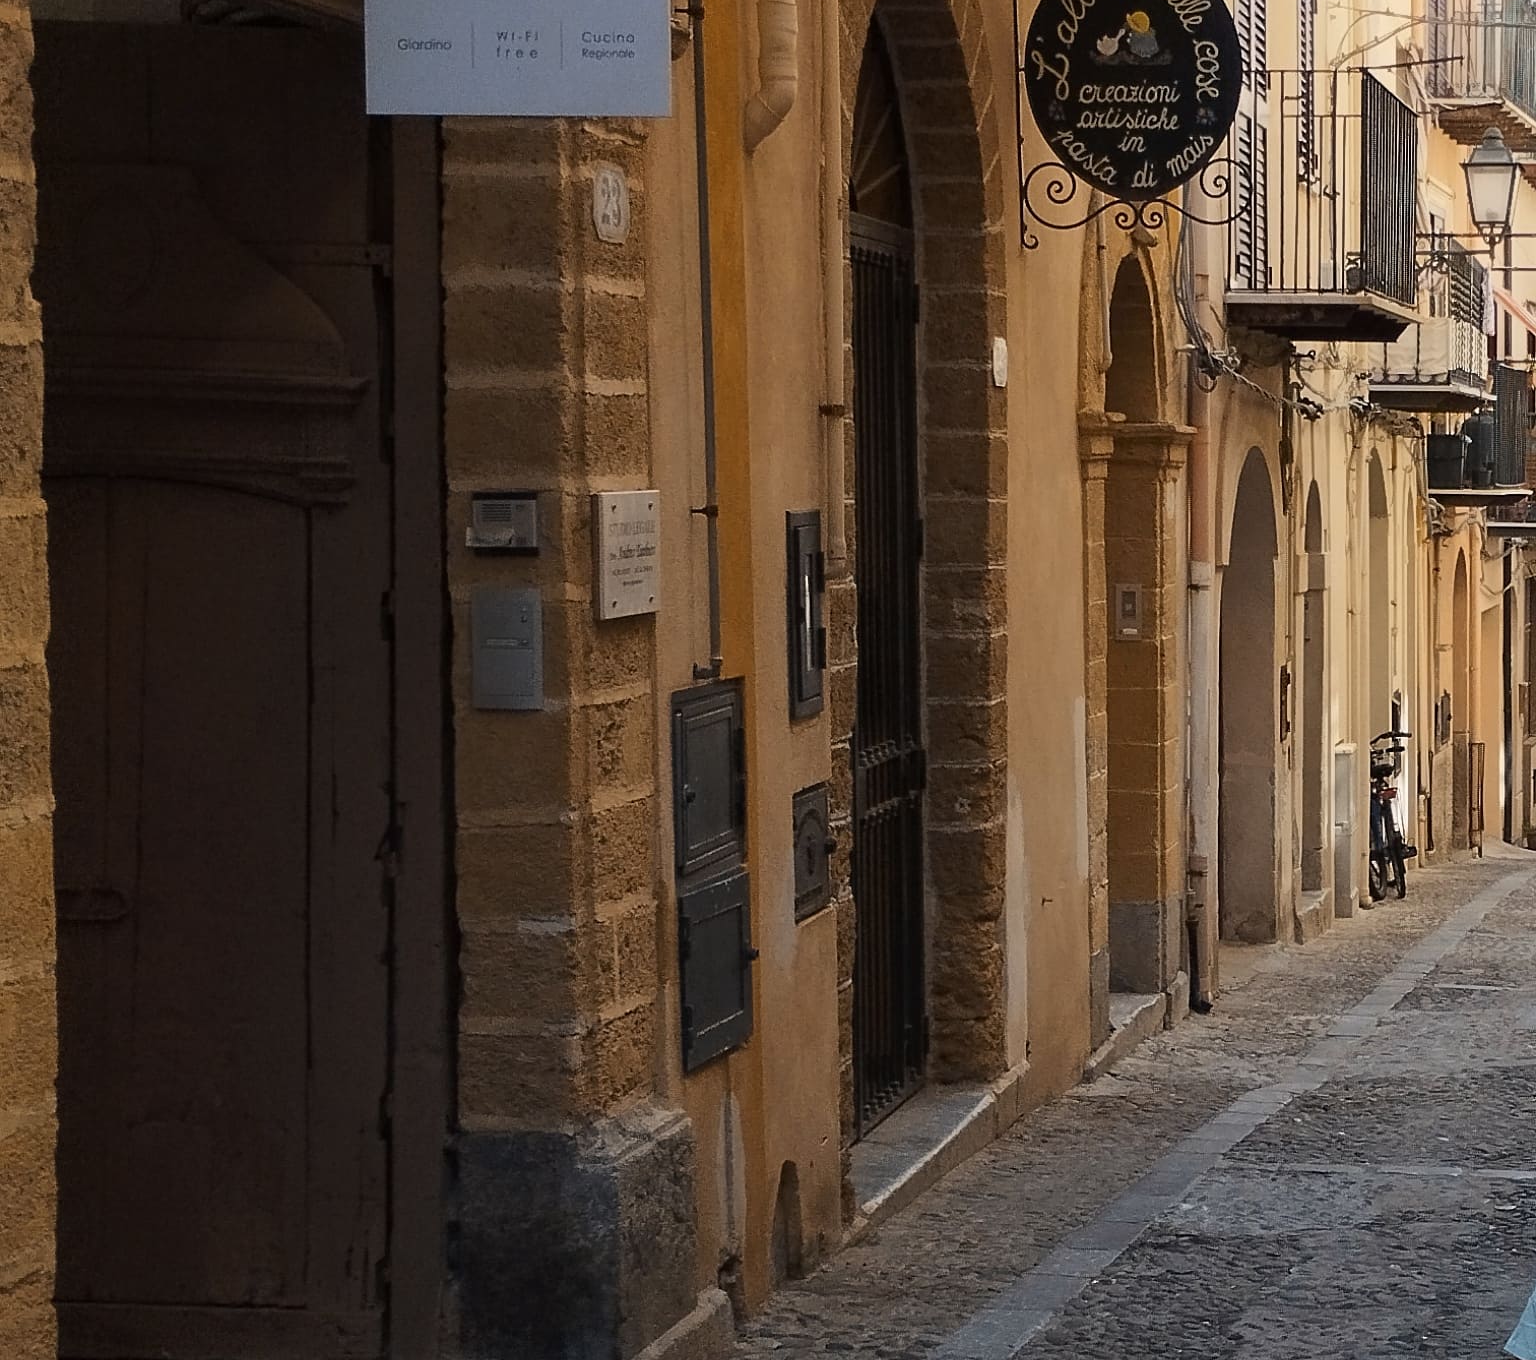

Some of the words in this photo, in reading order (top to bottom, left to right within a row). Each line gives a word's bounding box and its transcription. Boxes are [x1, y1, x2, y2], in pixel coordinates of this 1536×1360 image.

[397, 38, 452, 51] Giardino
[581, 31, 635, 44] Cucina
[496, 46, 538, 59] free
[581, 47, 635, 61] Regionale
[1193, 38, 1221, 103] cose
[1079, 79, 1180, 104] creazioni
[1076, 107, 1180, 130] artistiche
[1117, 131, 1147, 153] in
[1051, 130, 1117, 185] pasta
[1131, 160, 1157, 188] di
[1166, 135, 1214, 177] mais
